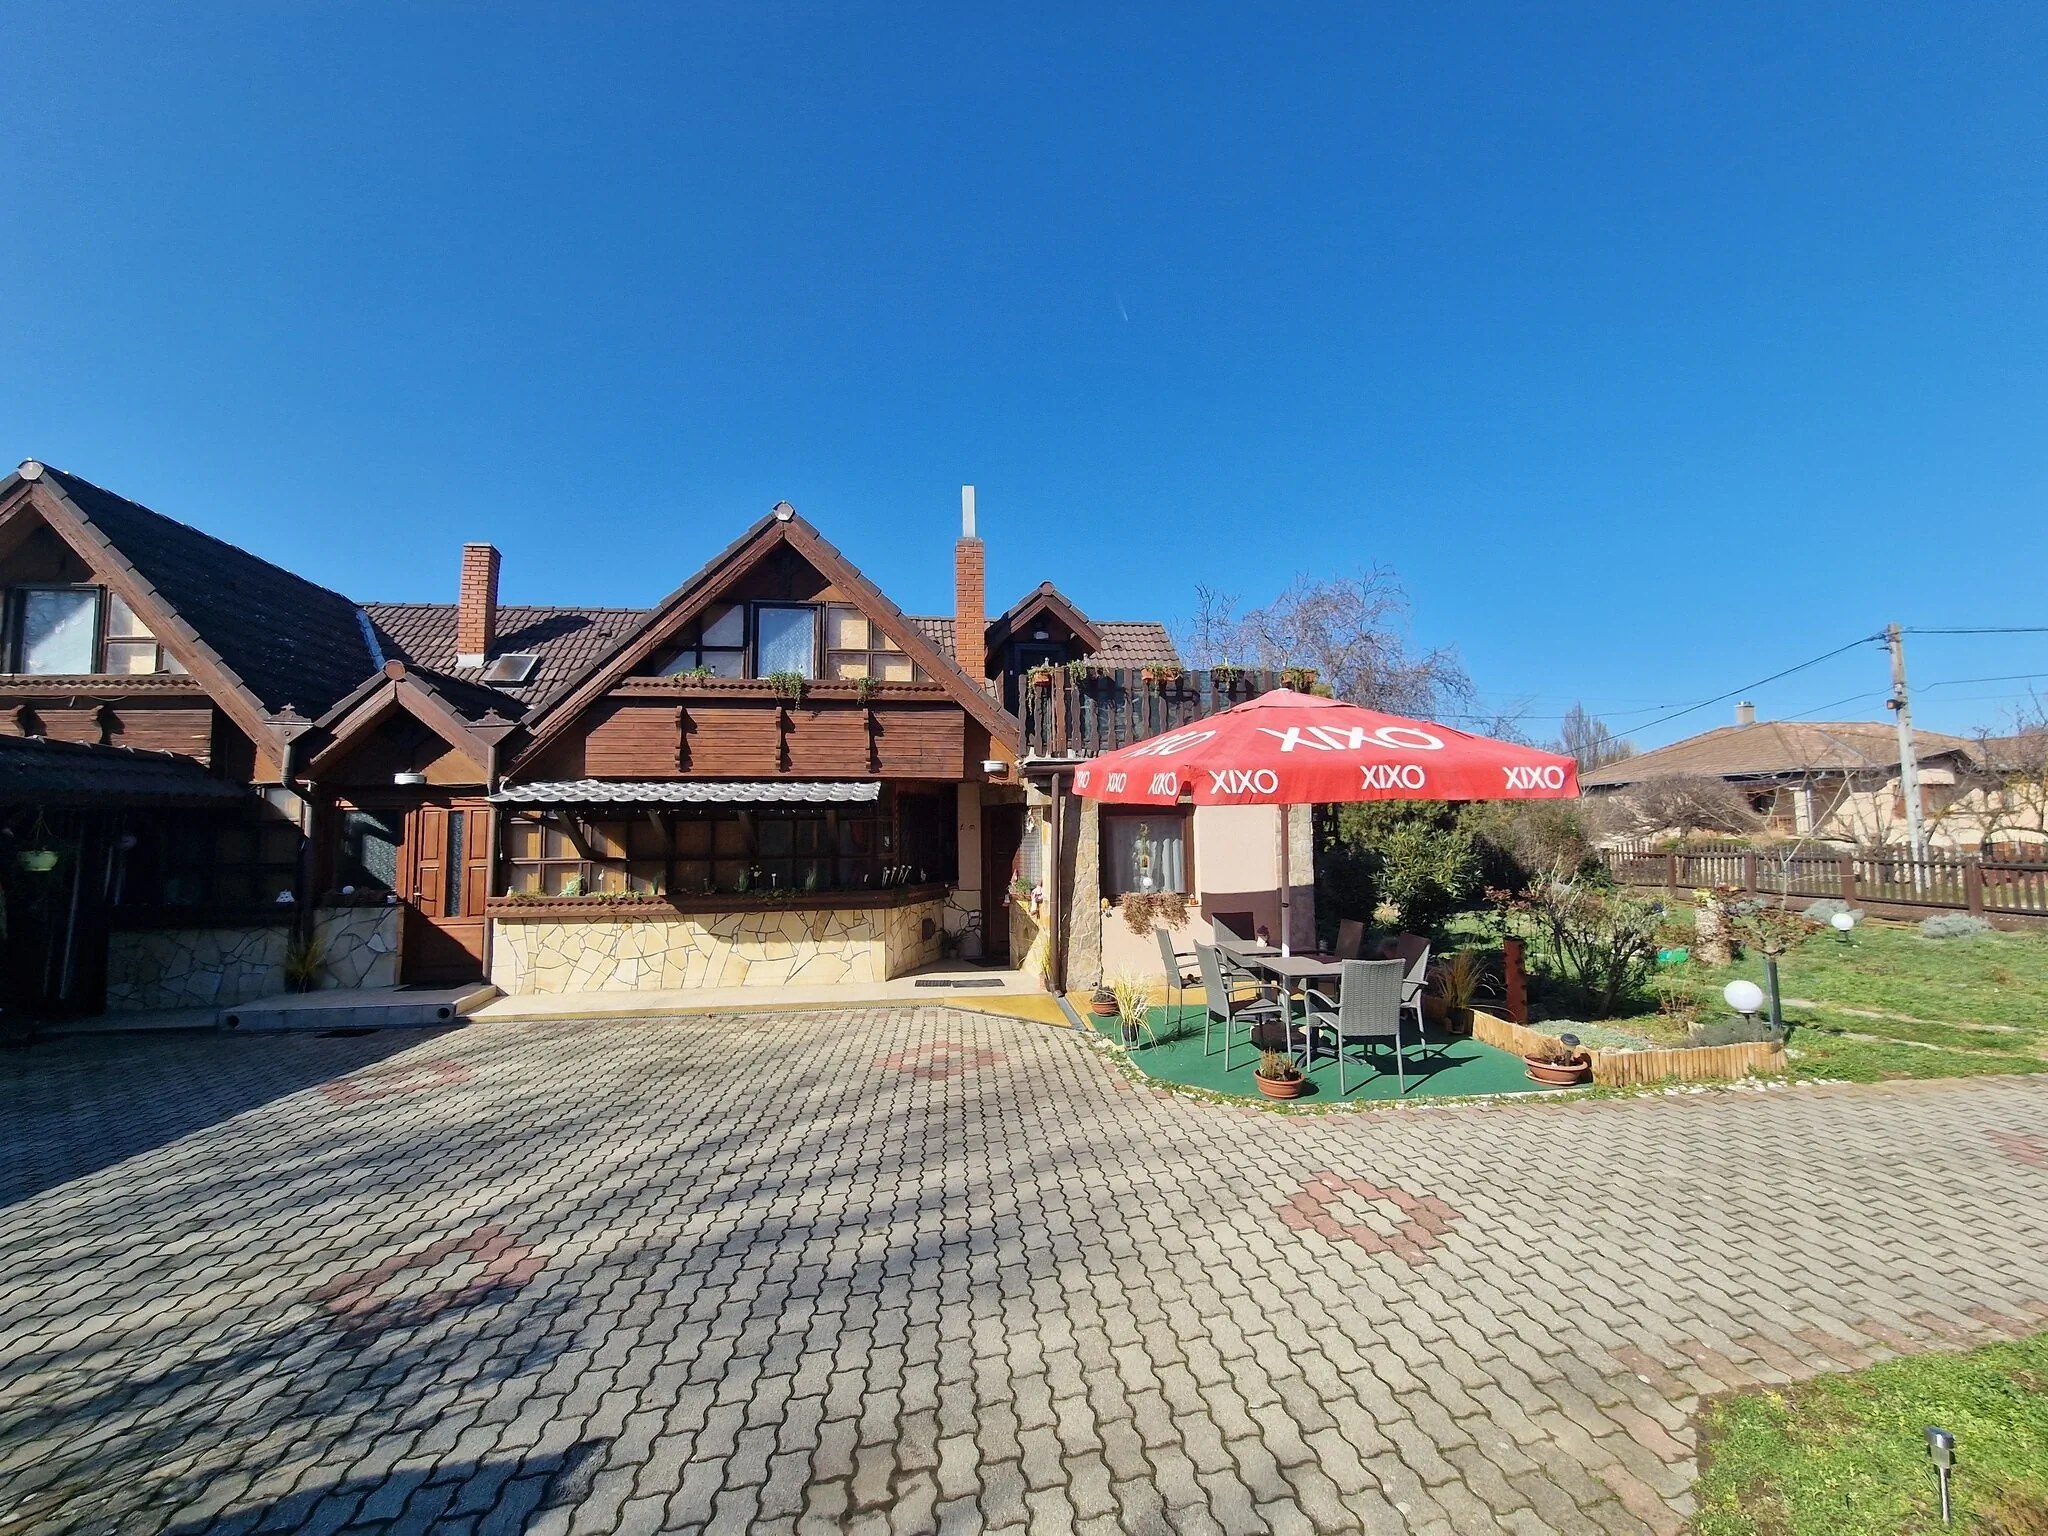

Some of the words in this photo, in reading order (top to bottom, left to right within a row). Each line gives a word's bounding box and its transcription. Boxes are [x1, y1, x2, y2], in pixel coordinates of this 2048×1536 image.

[1255, 726, 1445, 752] XIXO
[1106, 772, 1127, 794] XIXO
[1147, 771, 1178, 796] XIXO
[1208, 769, 1279, 794] XIXO
[1360, 764, 1425, 790] XIXO
[1502, 765, 1565, 790] XIXO
